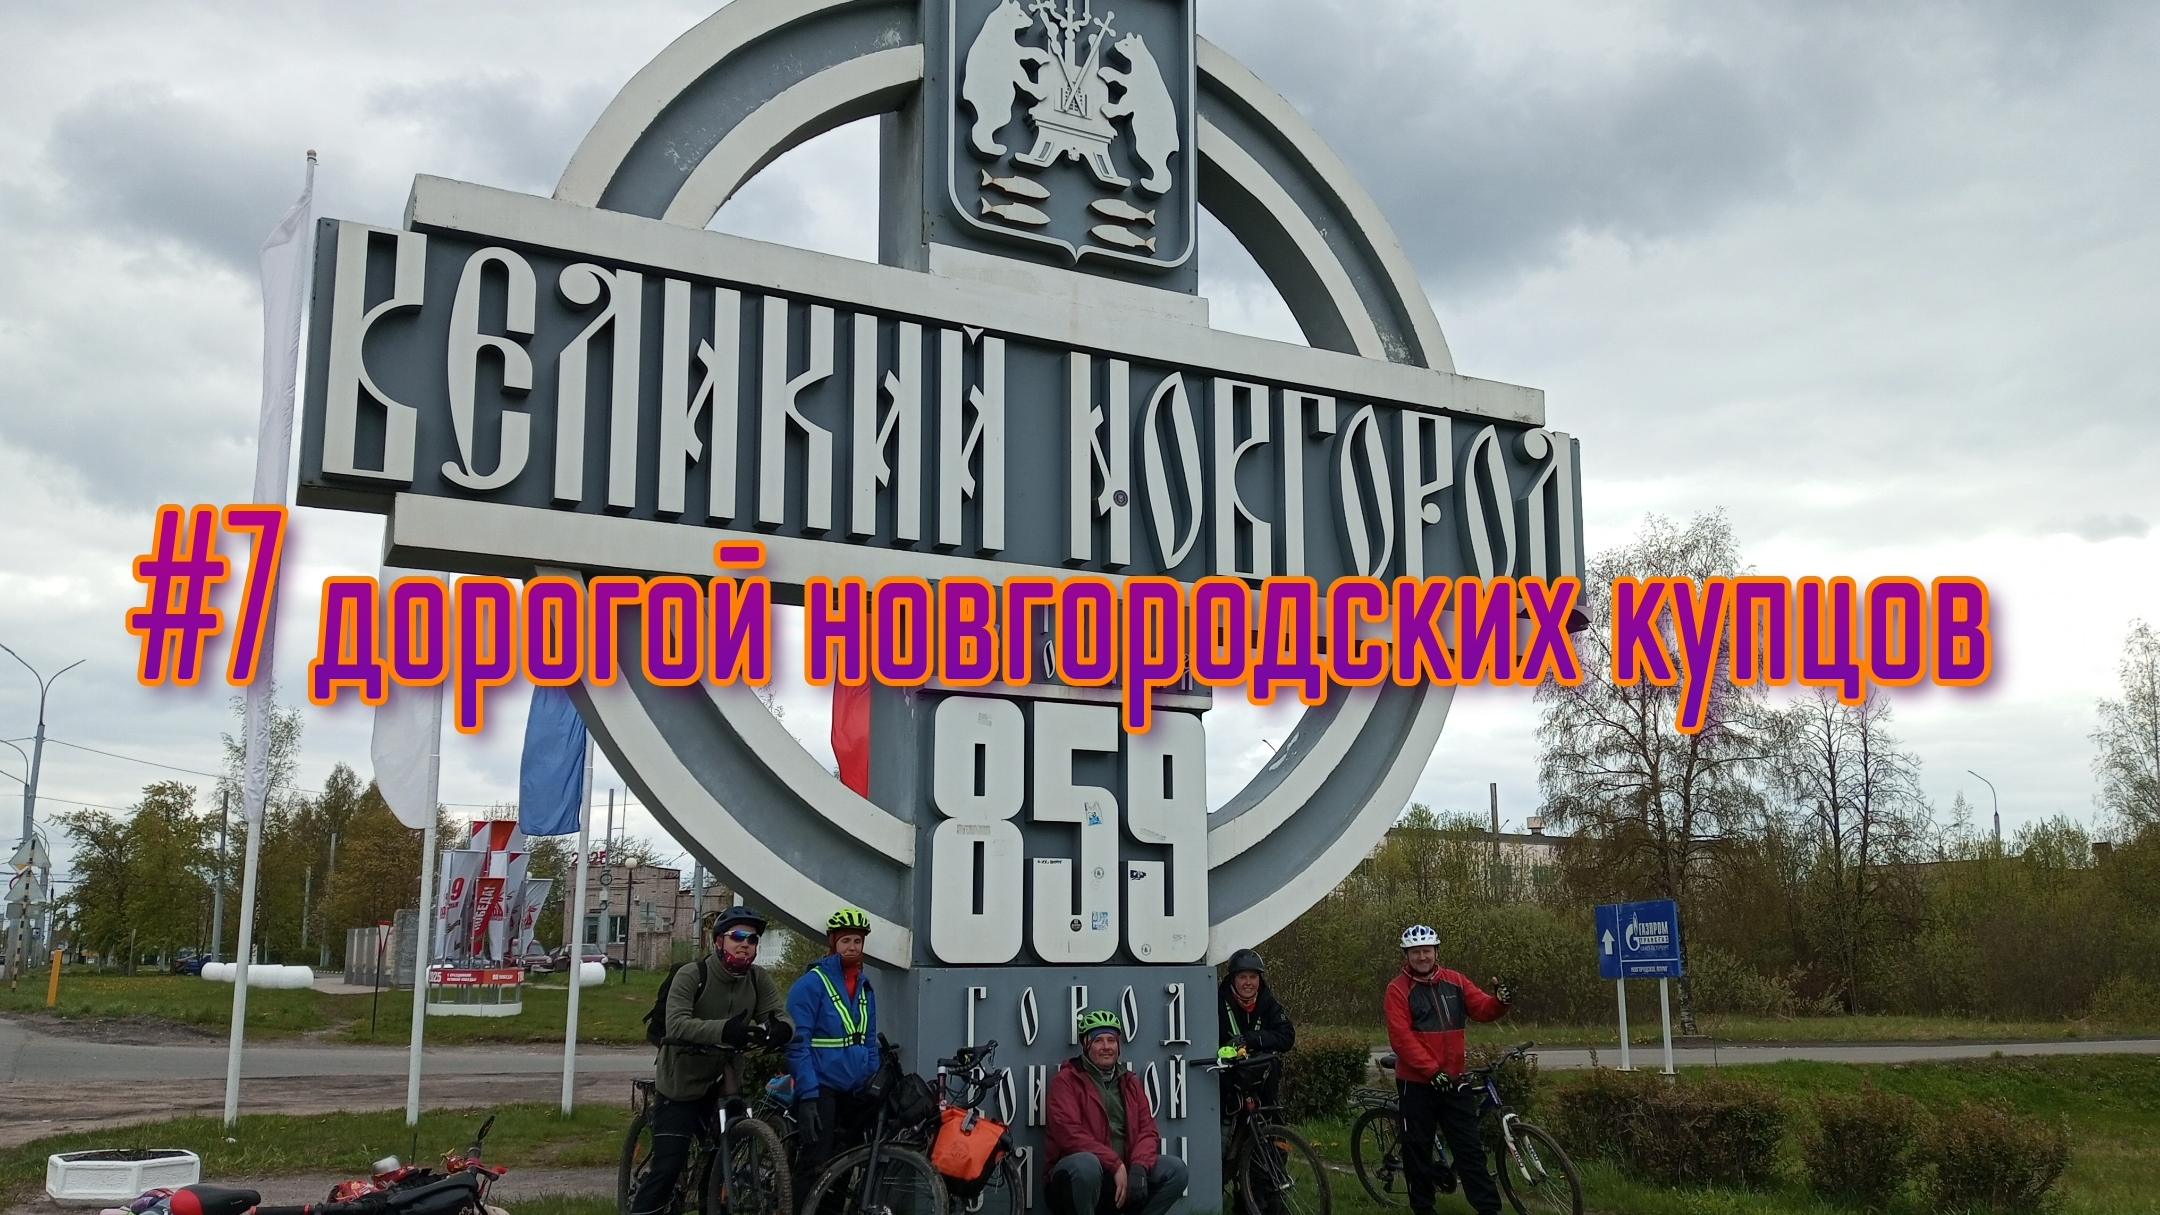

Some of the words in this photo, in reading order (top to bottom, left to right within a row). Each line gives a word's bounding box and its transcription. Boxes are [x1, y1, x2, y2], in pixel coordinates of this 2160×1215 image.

[322, 218, 1005, 553] ВЕЛИКИЙ
[571, 851, 607, 867] 225
[930, 695, 1209, 964] 859
[1638, 920, 1669, 936] ГАЗПРОМ
[966, 983, 1192, 1048] ГОРОД
